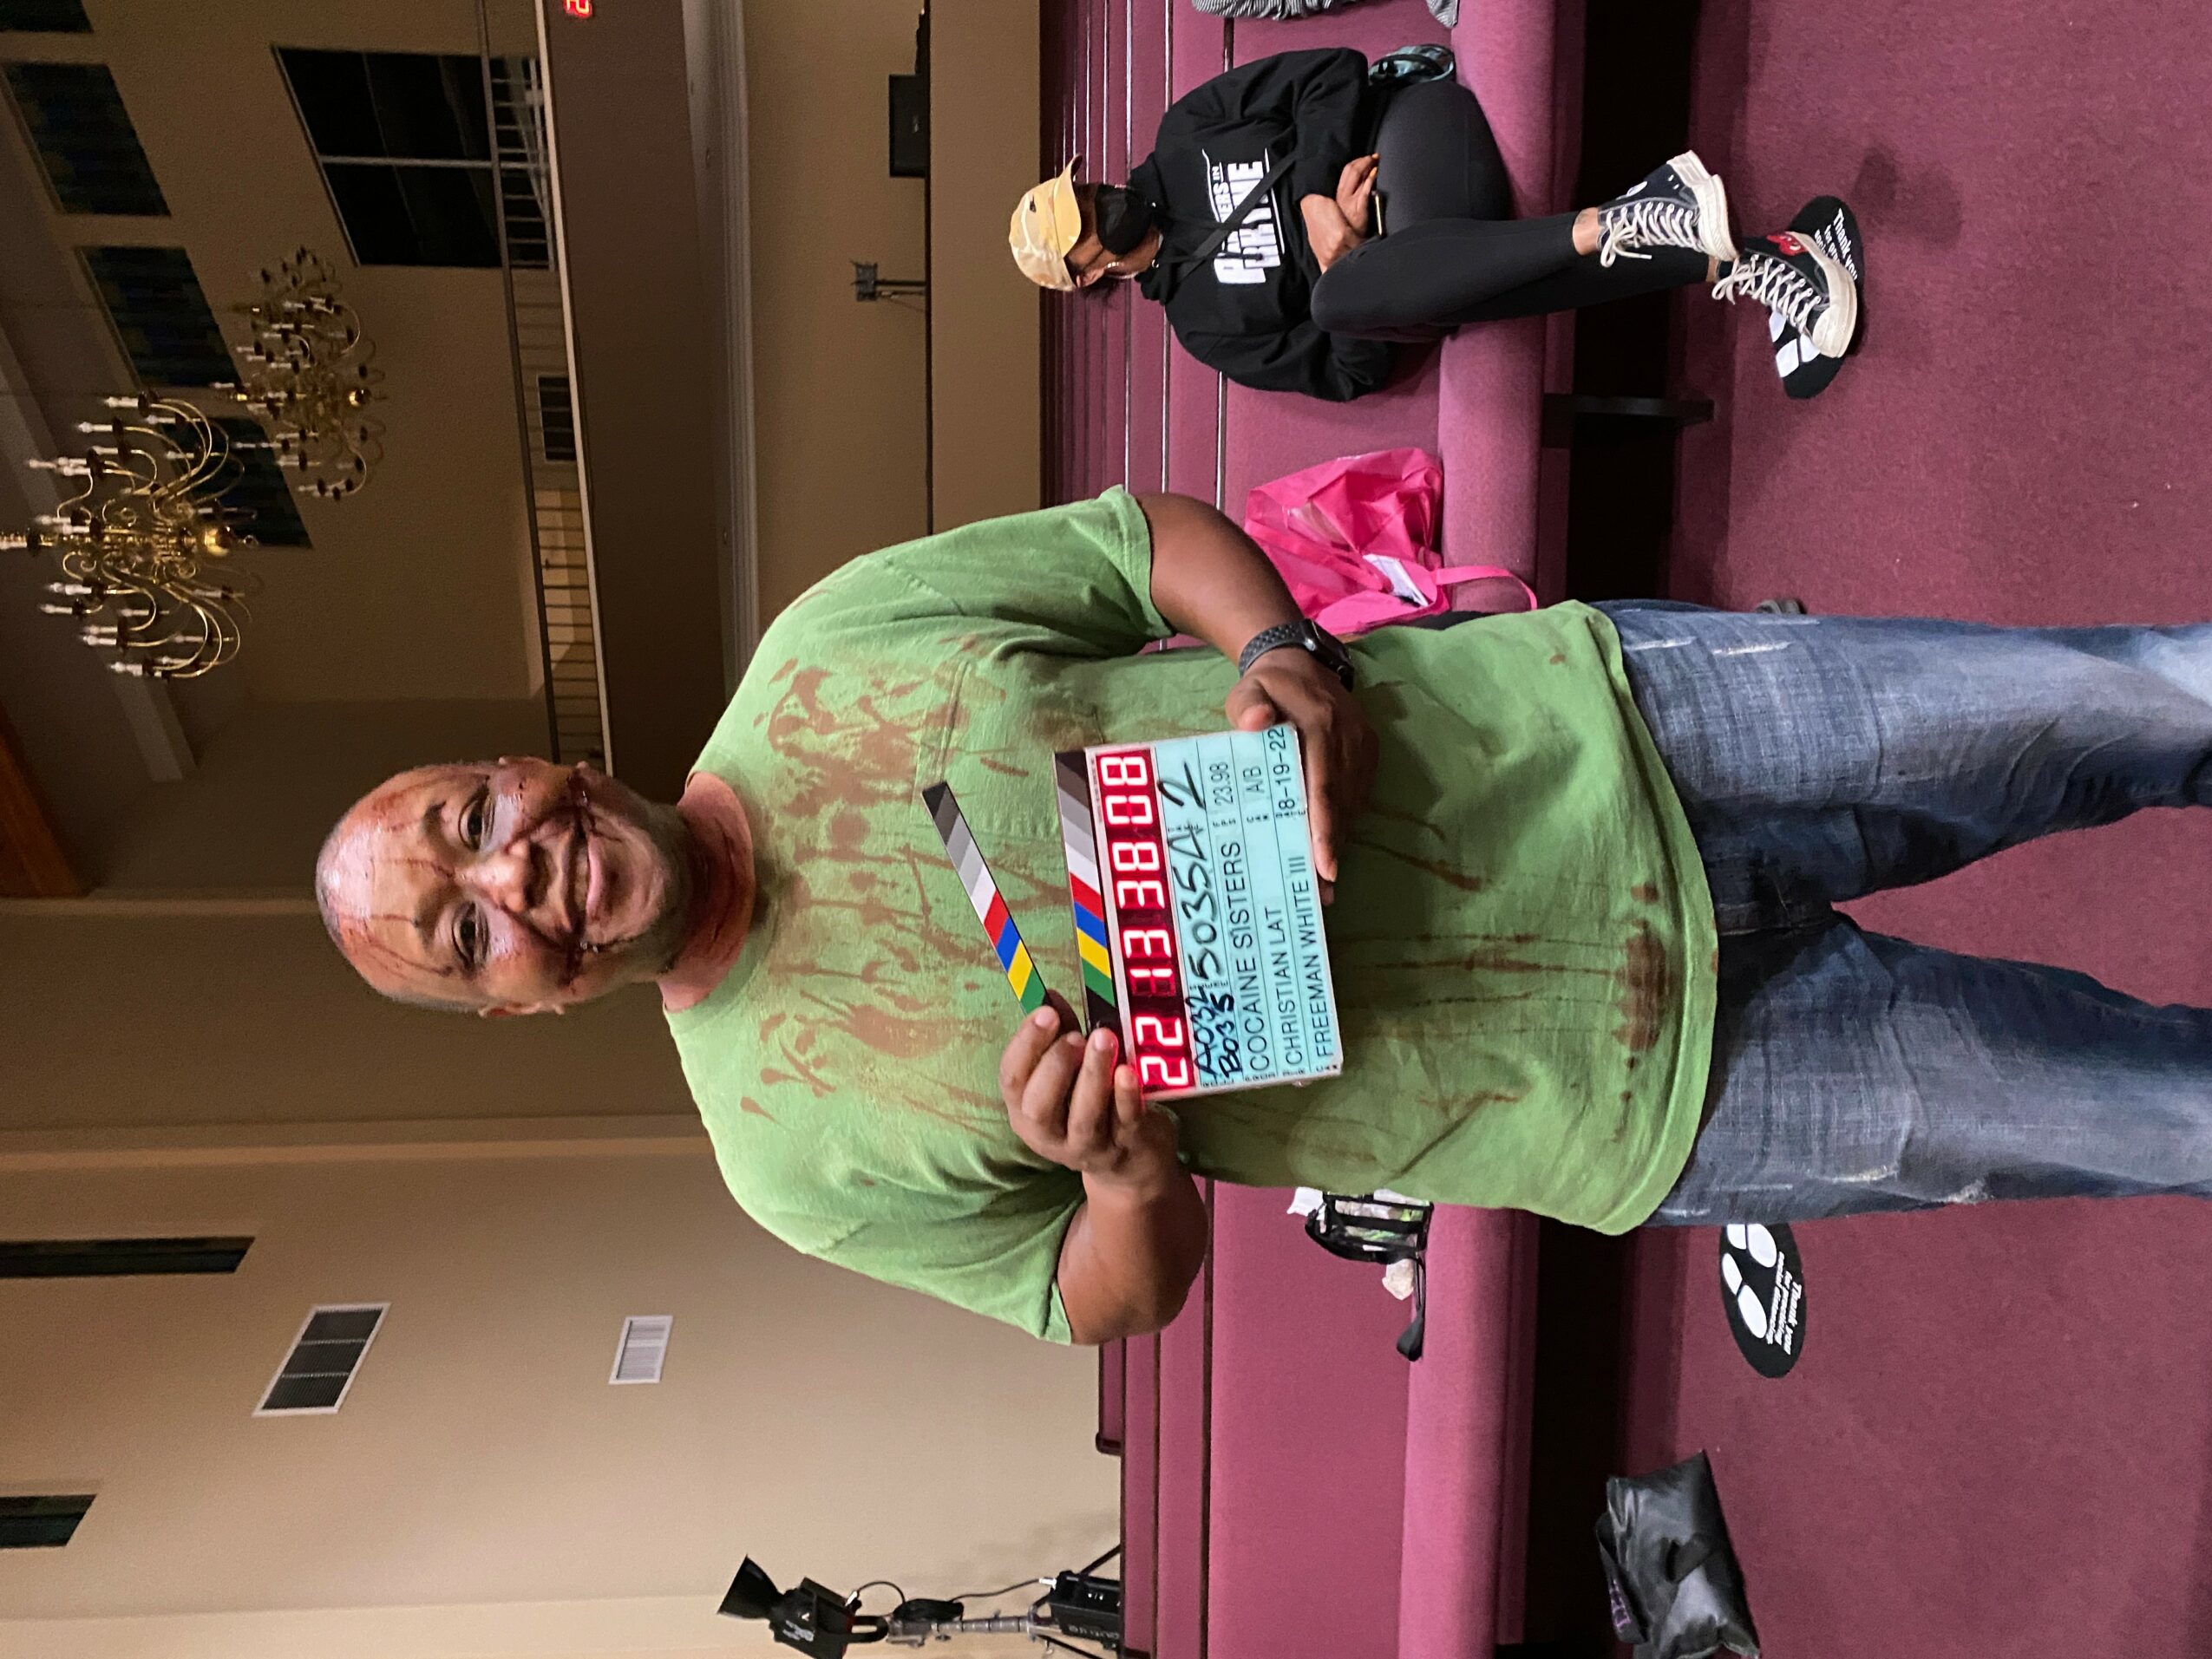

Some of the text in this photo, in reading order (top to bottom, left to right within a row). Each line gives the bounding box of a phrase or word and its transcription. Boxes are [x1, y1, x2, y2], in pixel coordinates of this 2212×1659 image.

[1212, 167, 1220, 180] IN
[1833, 208, 1851, 259] Thank
[1156, 762, 1206, 810] 2
[1209, 761, 1234, 806] 23.98
[1242, 766, 1265, 794] A/B
[1267, 728, 1295, 810] 8-19-22
[1100, 755, 1190, 1086] 22 13 38 08
[1221, 842, 1253, 949] SISTERS
[1265, 907, 1302, 1066] CHRISTIAN LAT
[1288, 856, 1333, 1057] FREEMAN WHITE III
[1236, 957, 1270, 1071] COCAINE
[1776, 1251, 1785, 1289] social
[1783, 1282, 1802, 1355] Thank you
